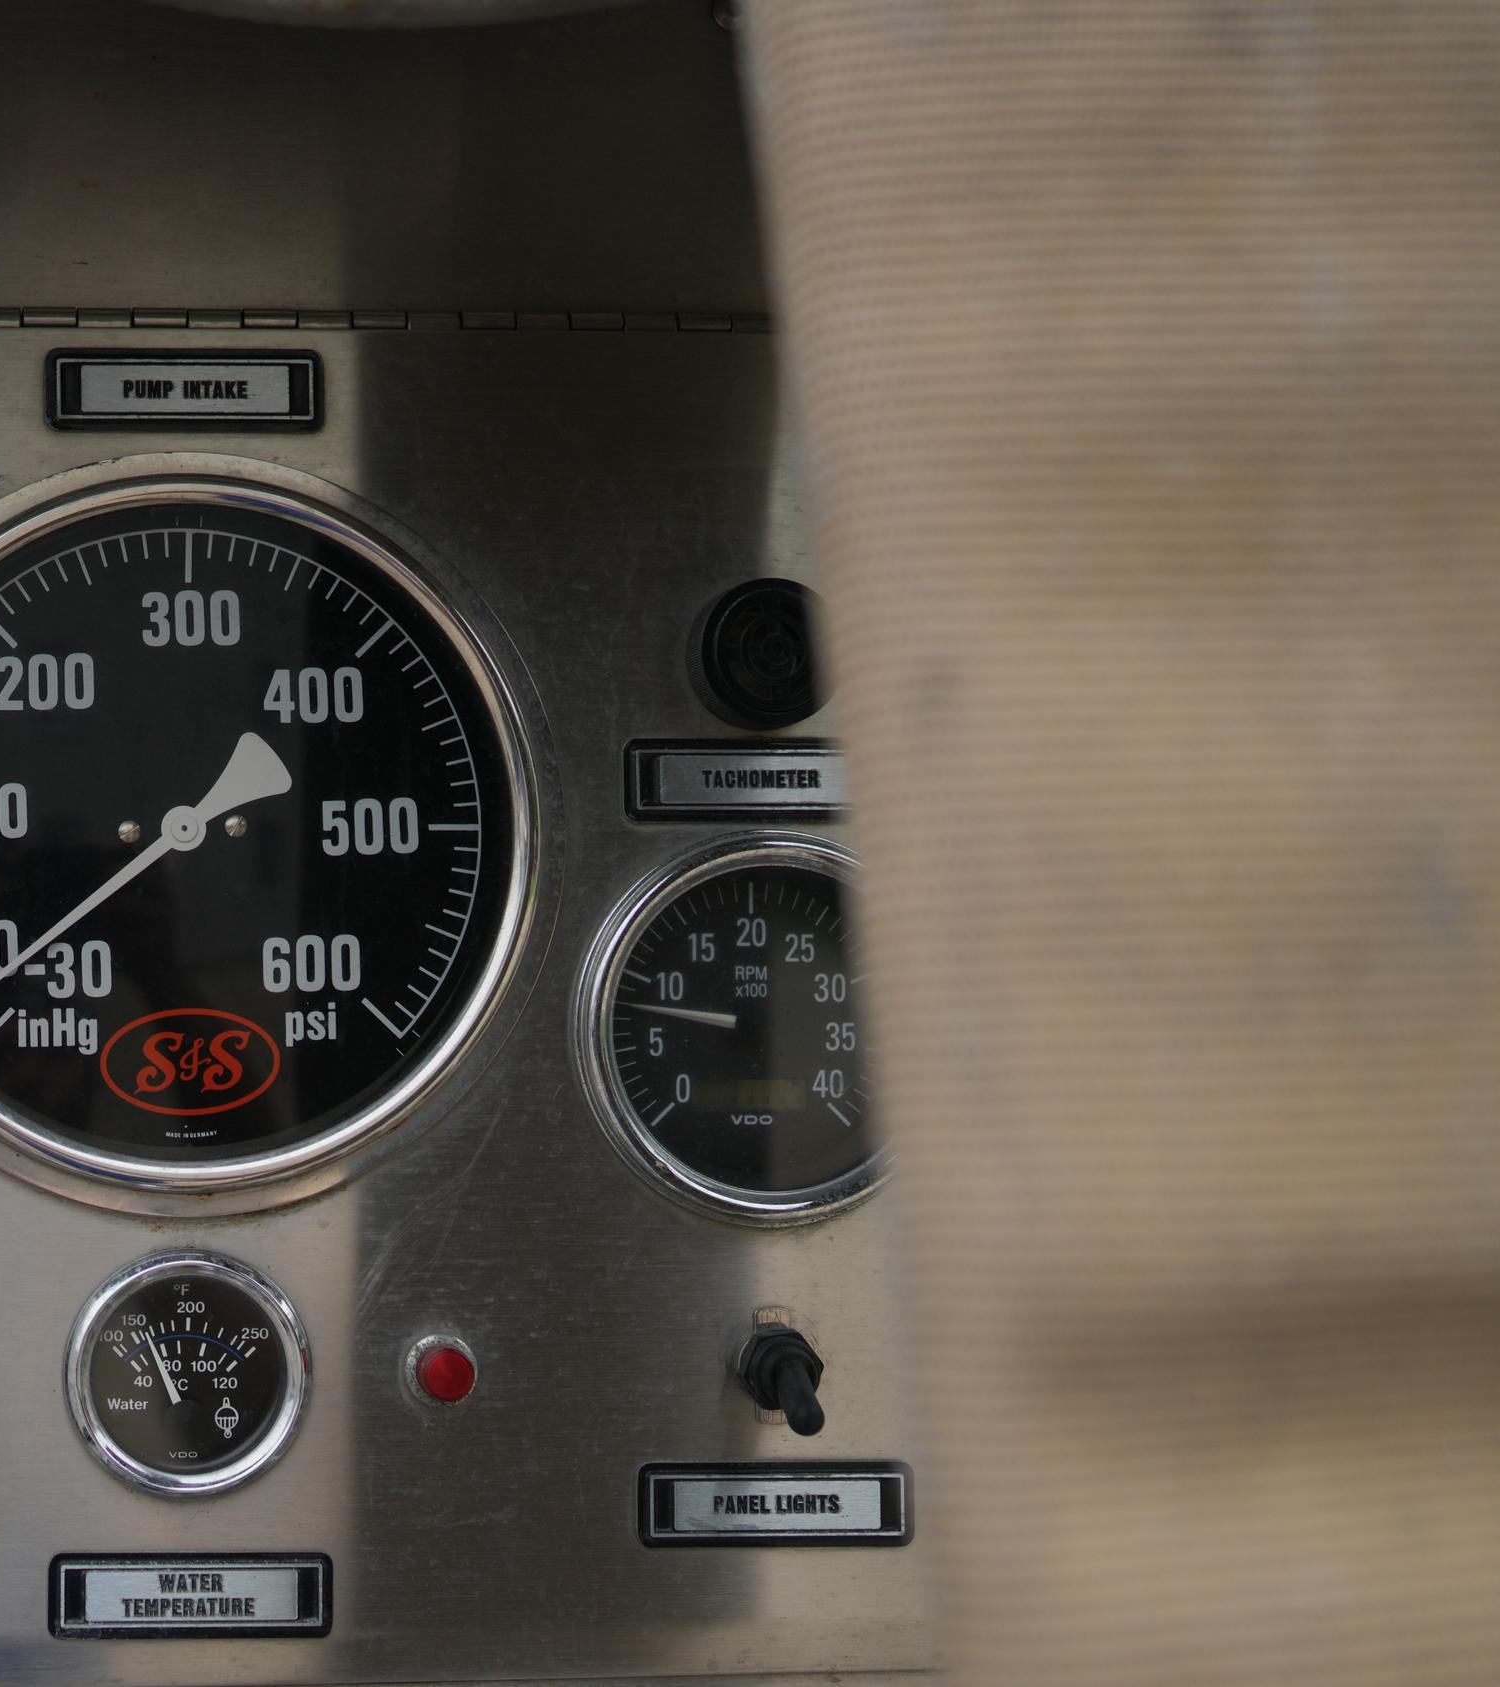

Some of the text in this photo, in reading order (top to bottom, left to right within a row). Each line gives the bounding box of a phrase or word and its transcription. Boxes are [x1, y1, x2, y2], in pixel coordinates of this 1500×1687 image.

[123, 380, 248, 399] PUMP INTAKE
[141, 590, 240, 647] 300
[263, 666, 364, 723] 400
[702, 769, 821, 789] TACHOMETER
[322, 797, 419, 857] 500
[736, 917, 767, 948] 20
[688, 933, 715, 962] 15
[784, 933, 815, 963] 25
[262, 934, 362, 993] 600
[735, 966, 768, 981] RPM
[656, 972, 684, 1001] 10
[735, 983, 768, 998] x100
[814, 973, 846, 1002] 30
[18, 1008, 98, 1055] inHg
[285, 1003, 337, 1047] psi
[825, 1022, 856, 1051] 35
[649, 1027, 663, 1056] 5
[132, 1029, 251, 1095] S&S
[676, 1073, 691, 1103] 0
[812, 1069, 844, 1098] 40
[731, 1114, 773, 1126] VDO
[122, 1314, 146, 1326] 150
[177, 1301, 205, 1313] 200
[241, 1328, 269, 1340] 250
[190, 1360, 217, 1372] 100
[133, 1375, 153, 1387] 40
[212, 1377, 238, 1389] 120
[107, 1398, 148, 1410] Water
[713, 1494, 840, 1514] PANEL LIGHTS
[158, 1573, 223, 1593] WATER
[121, 1597, 255, 1617] TEMPERATURE
